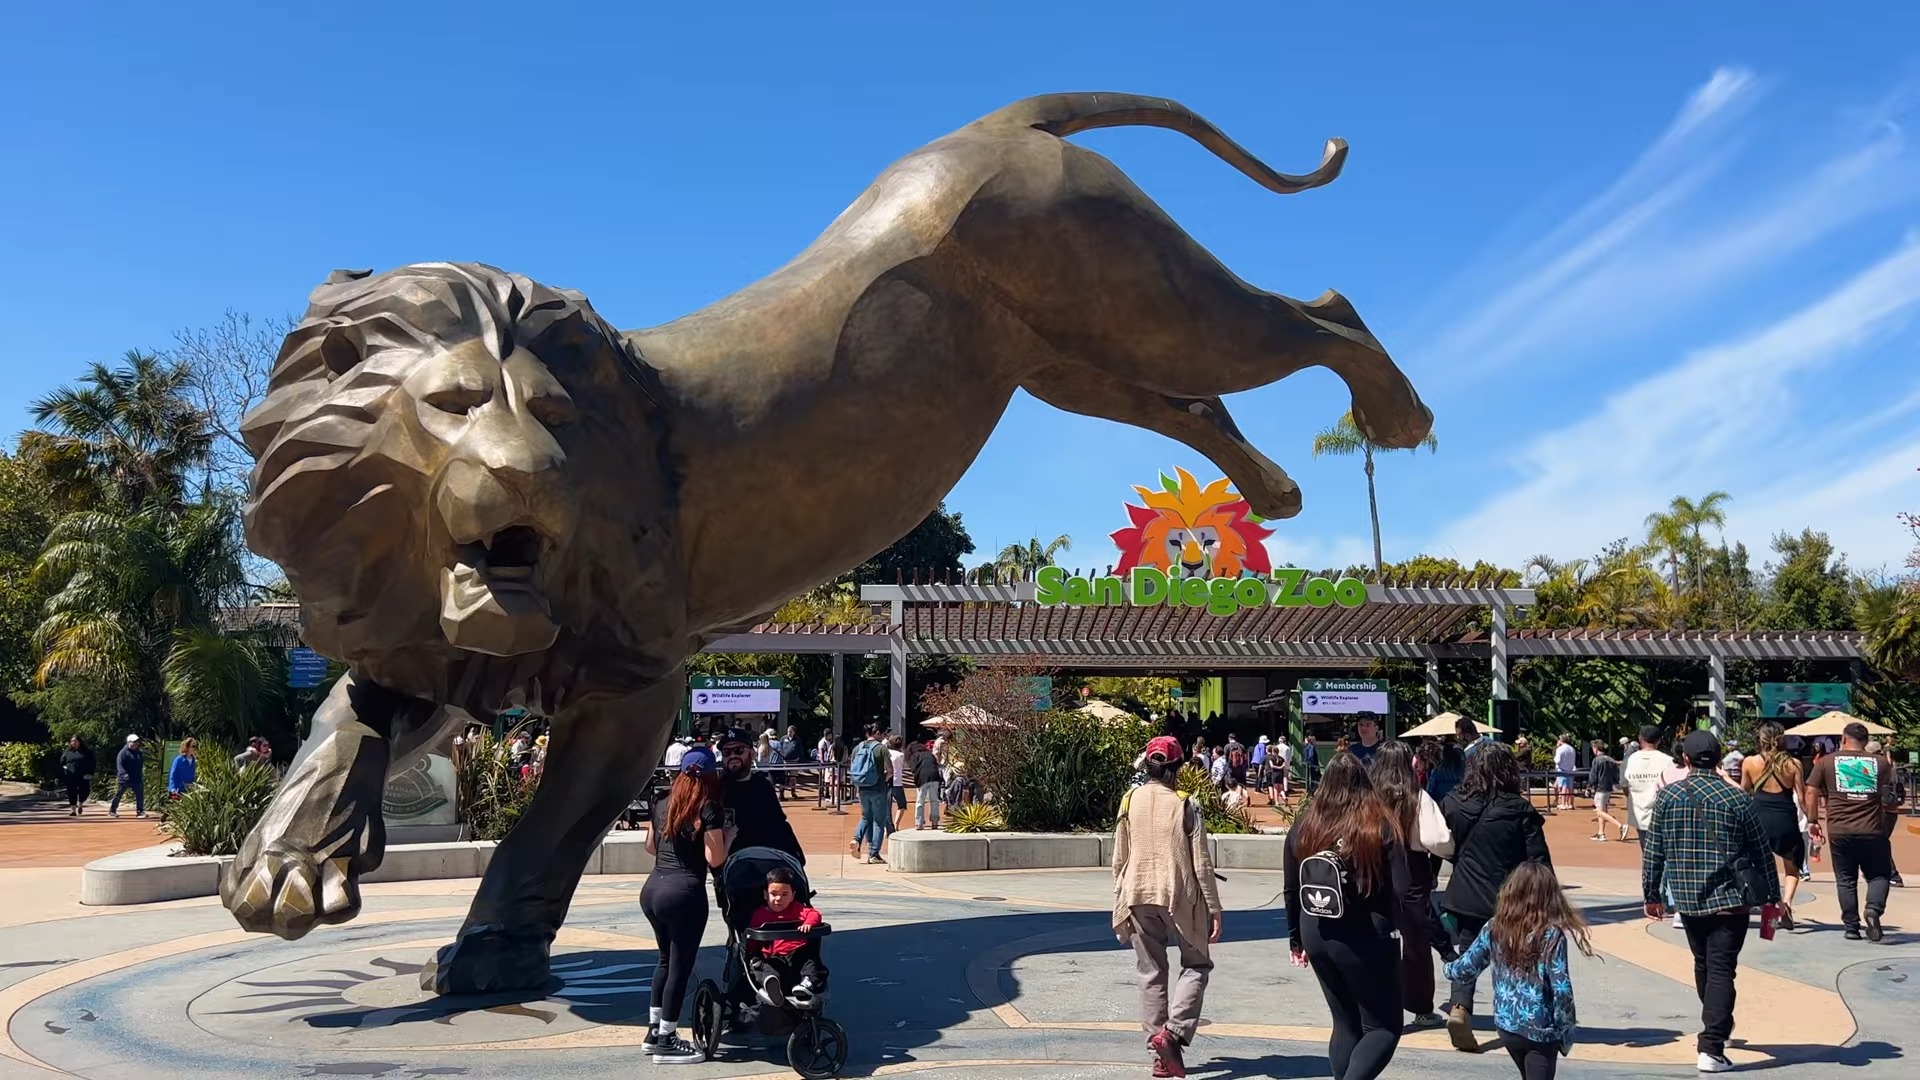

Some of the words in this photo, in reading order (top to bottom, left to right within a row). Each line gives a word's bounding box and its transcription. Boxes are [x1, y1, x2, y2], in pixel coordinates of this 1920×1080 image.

[1035, 565, 1122, 607] San
[1130, 564, 1267, 617] Diego
[1271, 567, 1366, 608] Zoo
[717, 679, 770, 688] Membership
[1325, 682, 1377, 691] Membership
[1310, 906, 1332, 914] adidas
